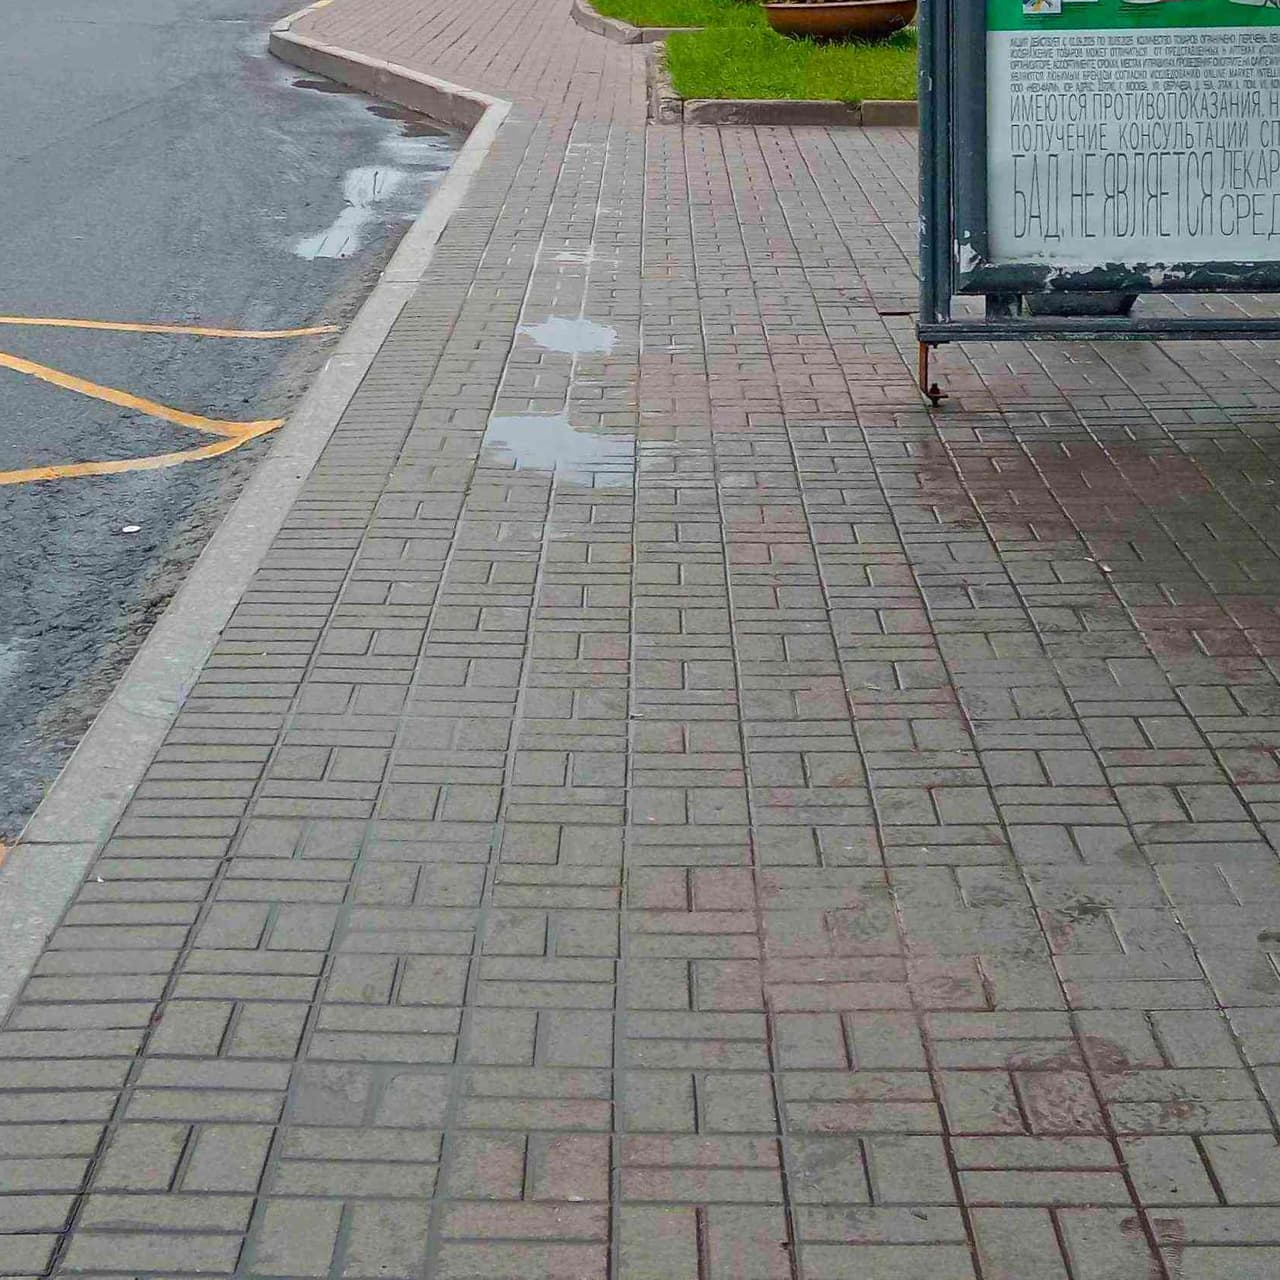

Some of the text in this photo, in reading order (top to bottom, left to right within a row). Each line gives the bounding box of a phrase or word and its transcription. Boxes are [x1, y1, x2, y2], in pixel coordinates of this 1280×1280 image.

[1010, 93, 1087, 121] ИМЕЮТСЯ
[1093, 90, 1265, 120] ПРОТИВОПОКАЗАНИЯ.
[1010, 122, 1108, 152] ПОЛУЧЕНИЕ
[1119, 120, 1249, 151] КОНСУЛЬТАЦИИ
[1071, 153, 1096, 237] НЕ
[1104, 151, 1213, 237] ЯВЛЯЕТСЯ
